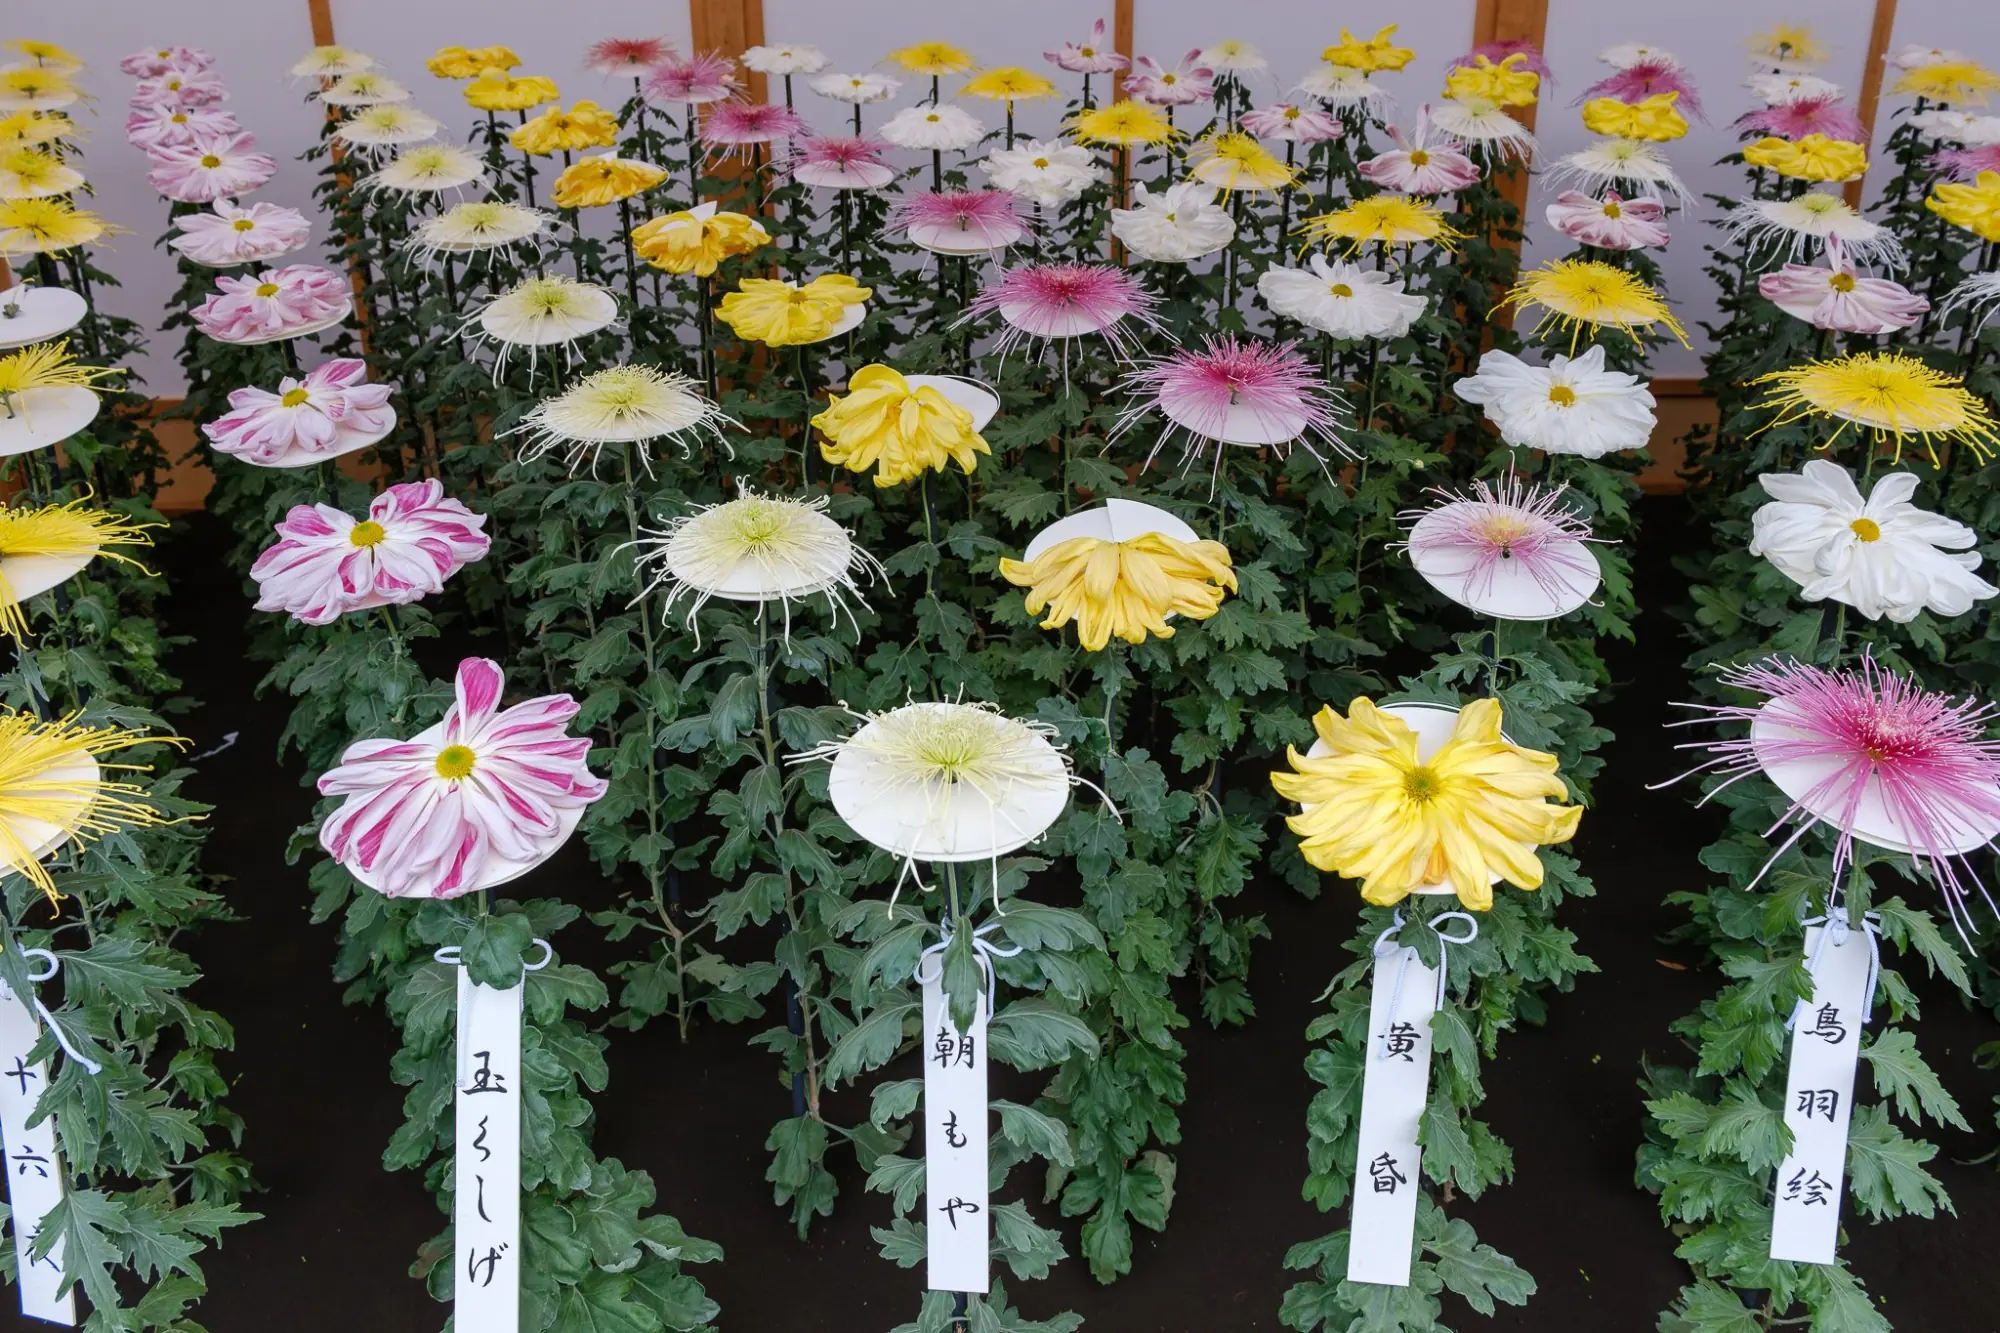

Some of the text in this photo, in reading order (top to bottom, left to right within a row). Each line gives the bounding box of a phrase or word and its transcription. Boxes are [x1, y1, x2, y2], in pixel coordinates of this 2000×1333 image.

[934, 1026, 980, 1231] 朝もや
[1369, 1021, 1421, 1195] 黄昏
[1782, 1002, 1847, 1206] 鳥羽絵
